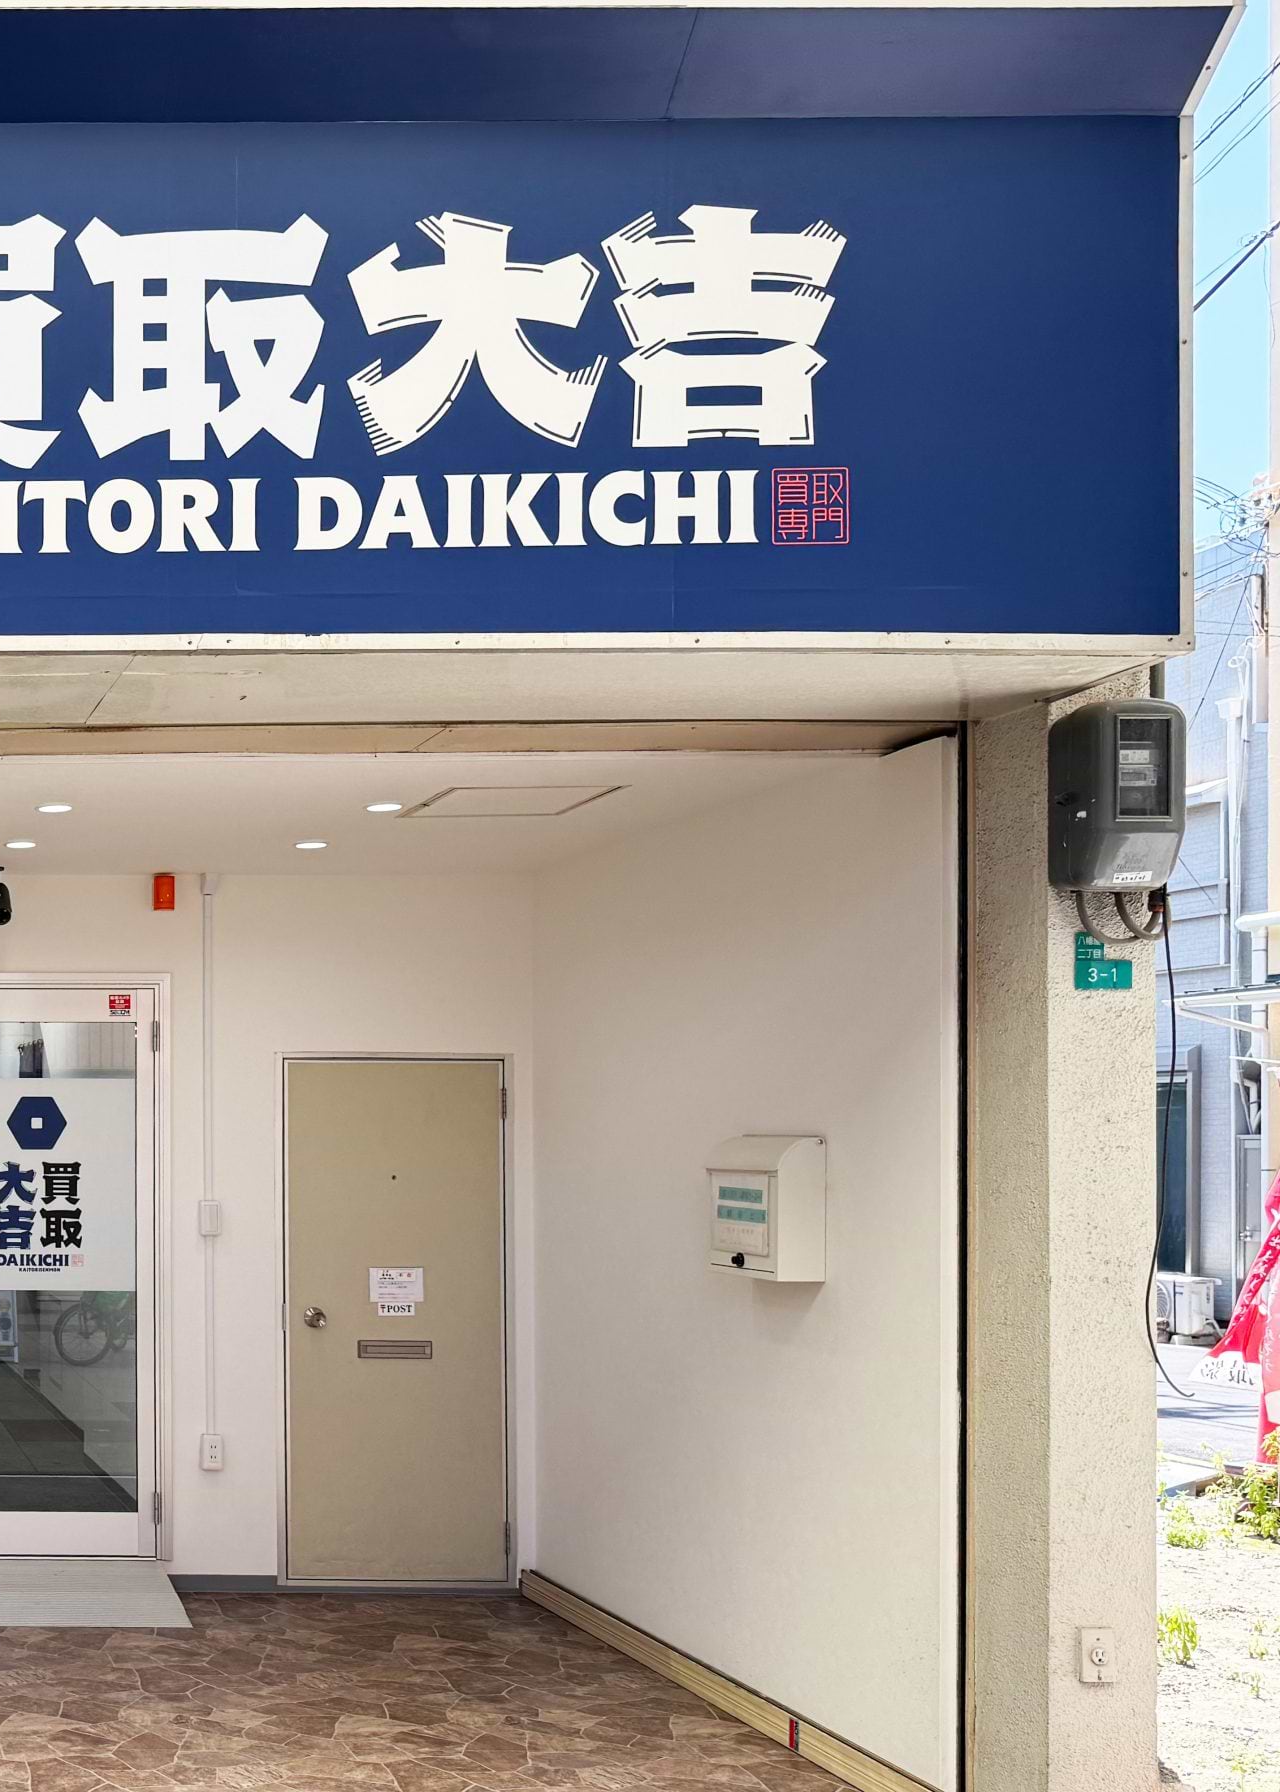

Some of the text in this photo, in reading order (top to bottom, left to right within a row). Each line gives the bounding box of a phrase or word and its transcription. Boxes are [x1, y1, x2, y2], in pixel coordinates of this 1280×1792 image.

[293, 469, 759, 551] DAIKICHI
[1077, 948, 1101, 959] 二丁目
[1087, 967, 1118, 983] 3-1
[39, 1161, 83, 1249] 買取
